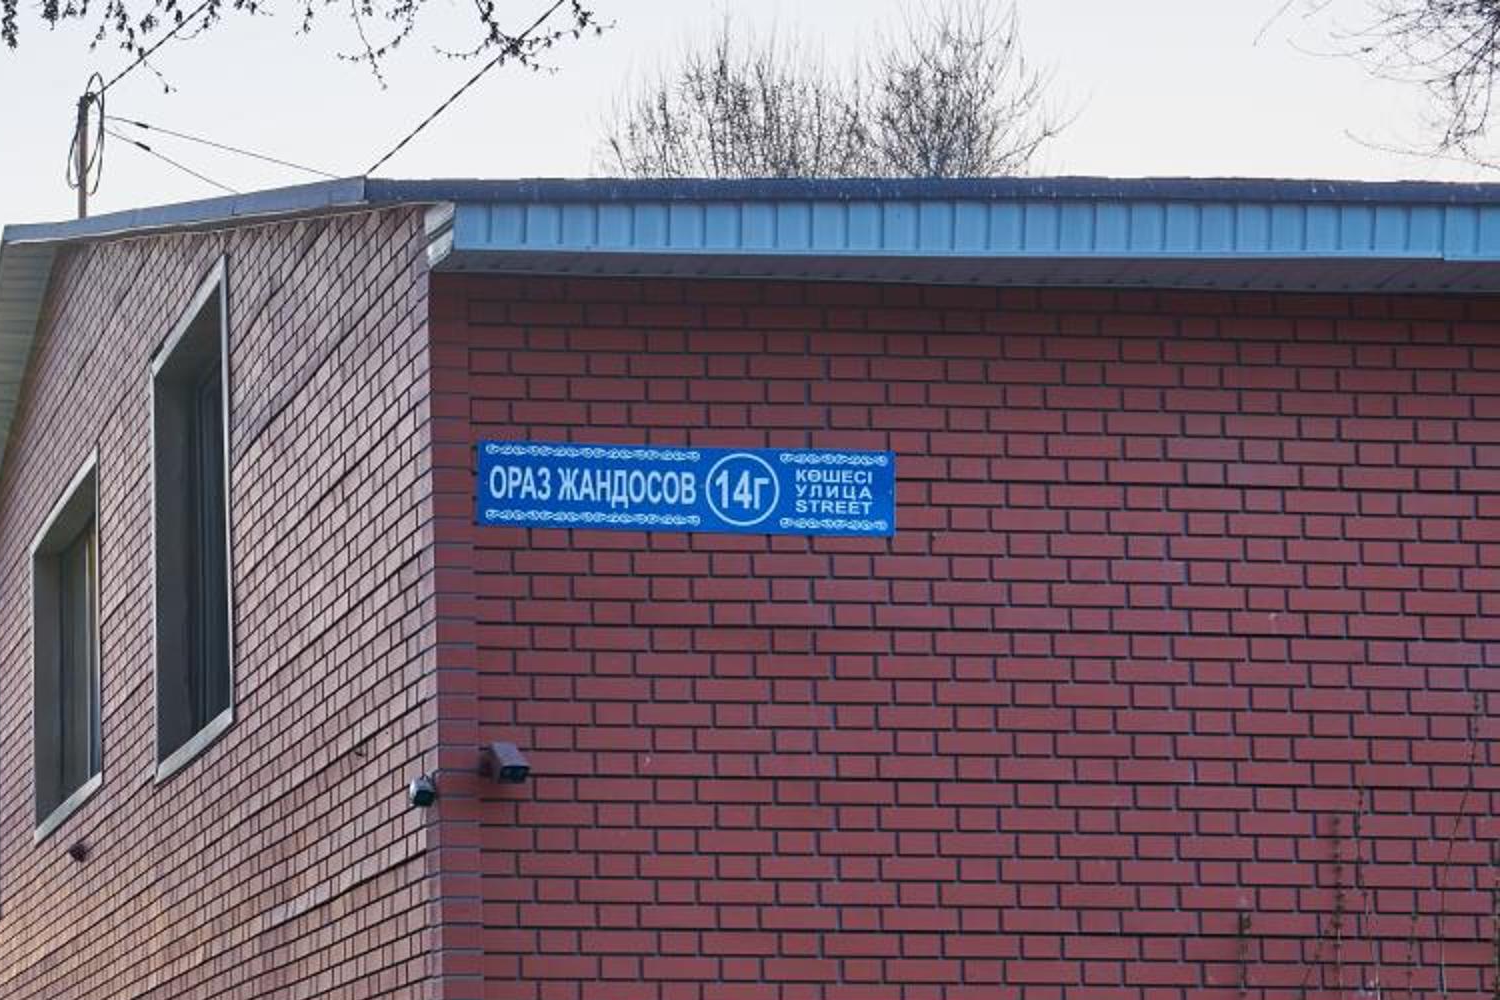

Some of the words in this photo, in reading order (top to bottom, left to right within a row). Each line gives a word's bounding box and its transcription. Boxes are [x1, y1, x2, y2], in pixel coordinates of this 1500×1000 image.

[795, 469, 873, 484] КӨШЕСІ
[488, 465, 550, 500] ОРАЗ
[557, 467, 697, 509] ЖАНДОСОВ
[795, 484, 873, 500] УЛИЦА
[795, 499, 873, 515] STREET
